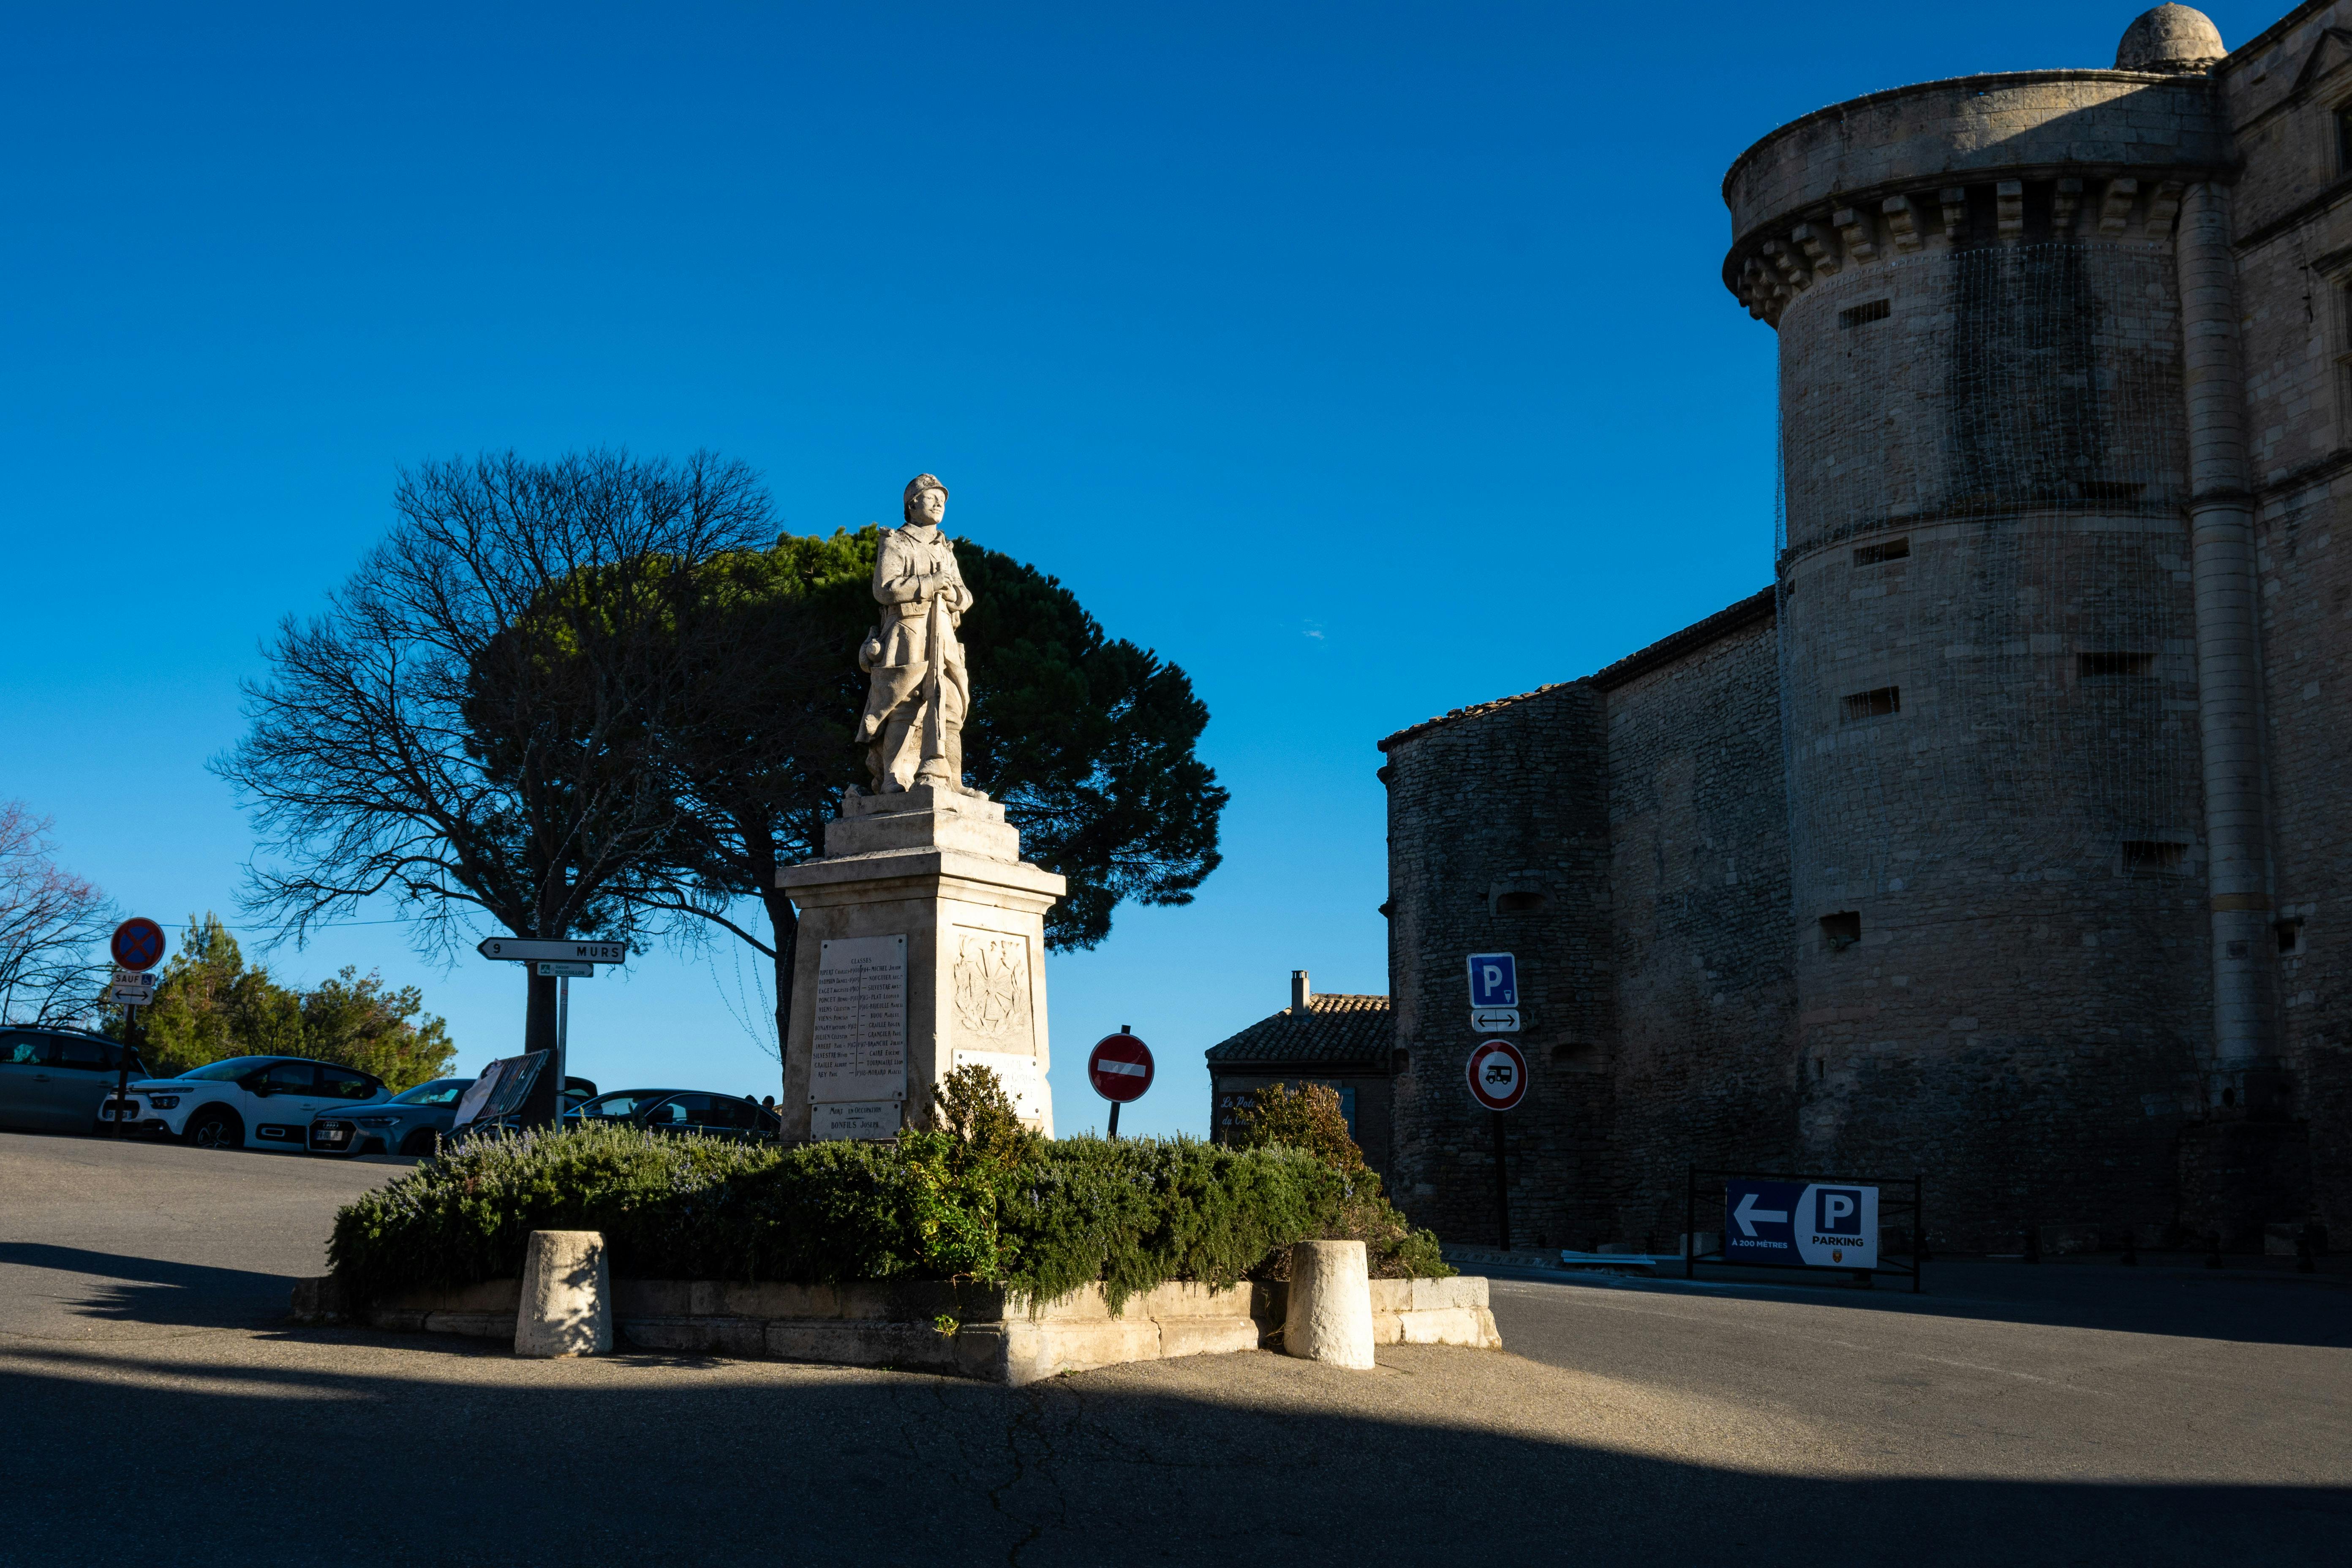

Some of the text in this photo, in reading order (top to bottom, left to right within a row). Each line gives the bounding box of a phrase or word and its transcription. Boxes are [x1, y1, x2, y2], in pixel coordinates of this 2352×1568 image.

[493, 943, 619, 958] 9 MURS
[115, 975, 139, 983] SAUF
[1483, 965, 1503, 996] P
[1220, 1096, 1233, 1108] Le
[830, 1107, 843, 1115] MORT
[831, 1121, 857, 1129] BONFILS
[1222, 1115, 1232, 1125] du
[1825, 1194, 1854, 1228] P
[1732, 1238, 1738, 1246] À
[1756, 1240, 1788, 1249] MÈTRES
[1812, 1236, 1864, 1247] PARKING
